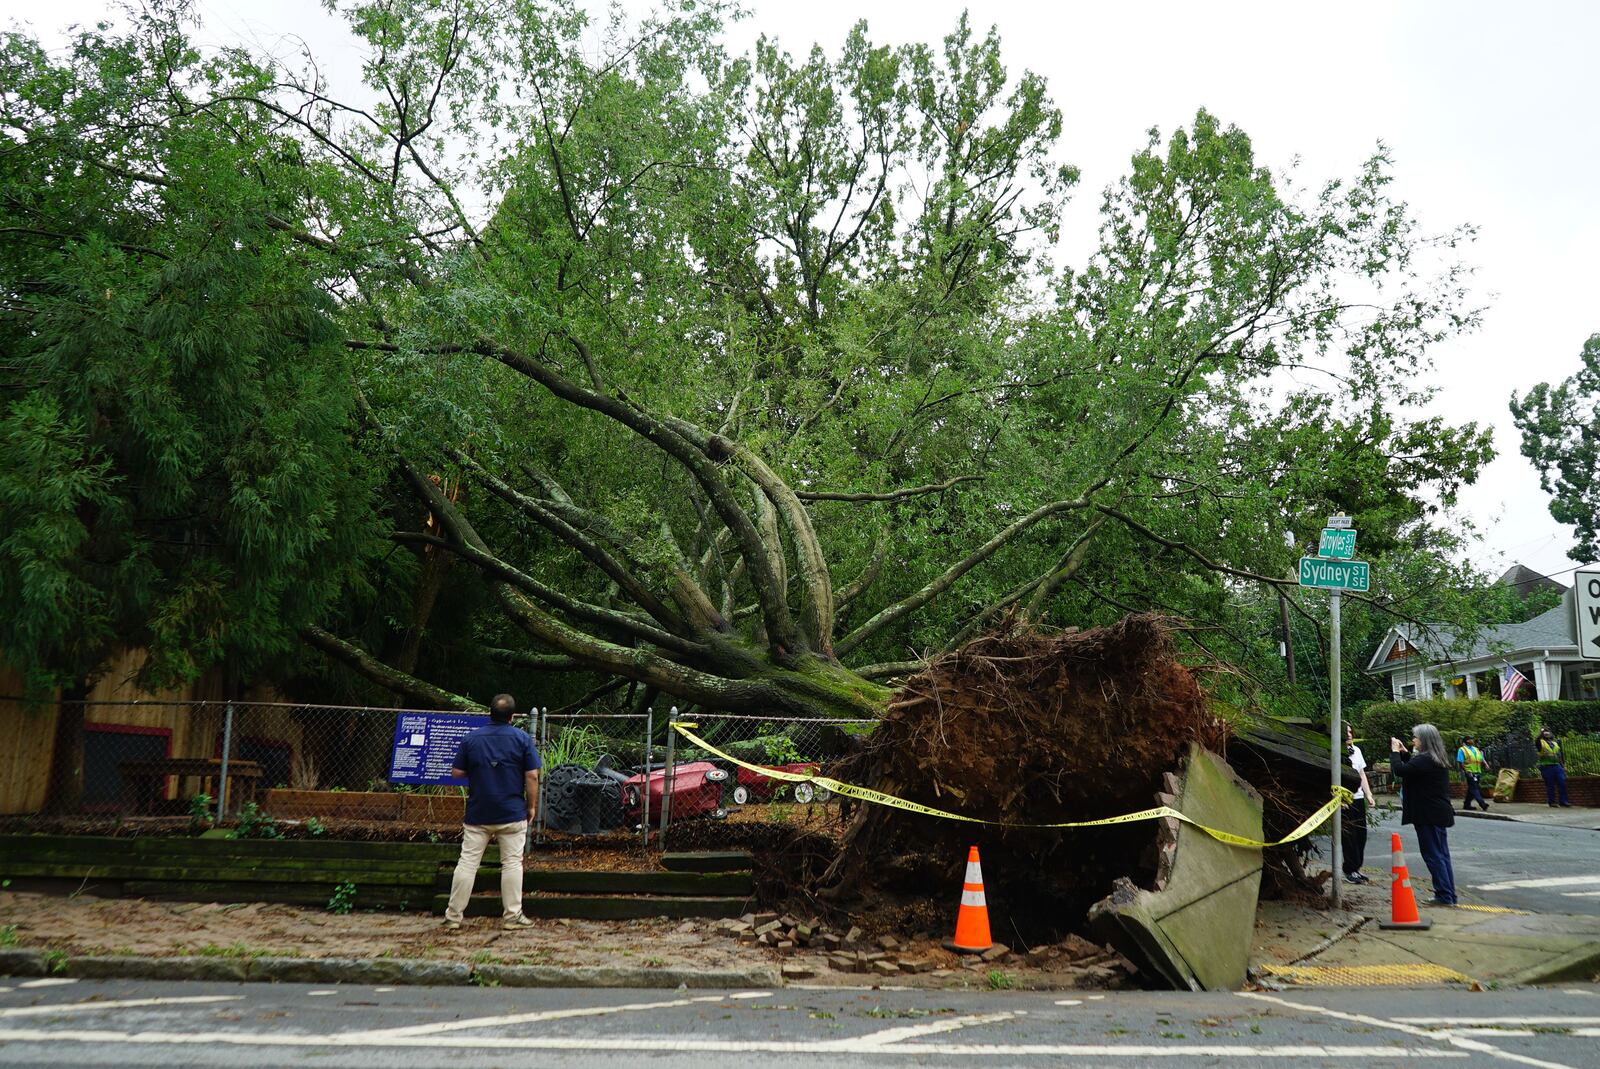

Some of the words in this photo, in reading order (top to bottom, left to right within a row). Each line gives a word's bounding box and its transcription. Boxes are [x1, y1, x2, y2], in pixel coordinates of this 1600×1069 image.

[1321, 531, 1346, 555] Broyles
[1346, 534, 1354, 544] ST
[1344, 546, 1352, 555] SE
[1303, 560, 1350, 587] Sydney
[1352, 566, 1366, 576] ST
[1352, 578, 1366, 587] SE
[850, 787, 880, 800] CUIDADO
[895, 798, 924, 812] CAUTION
